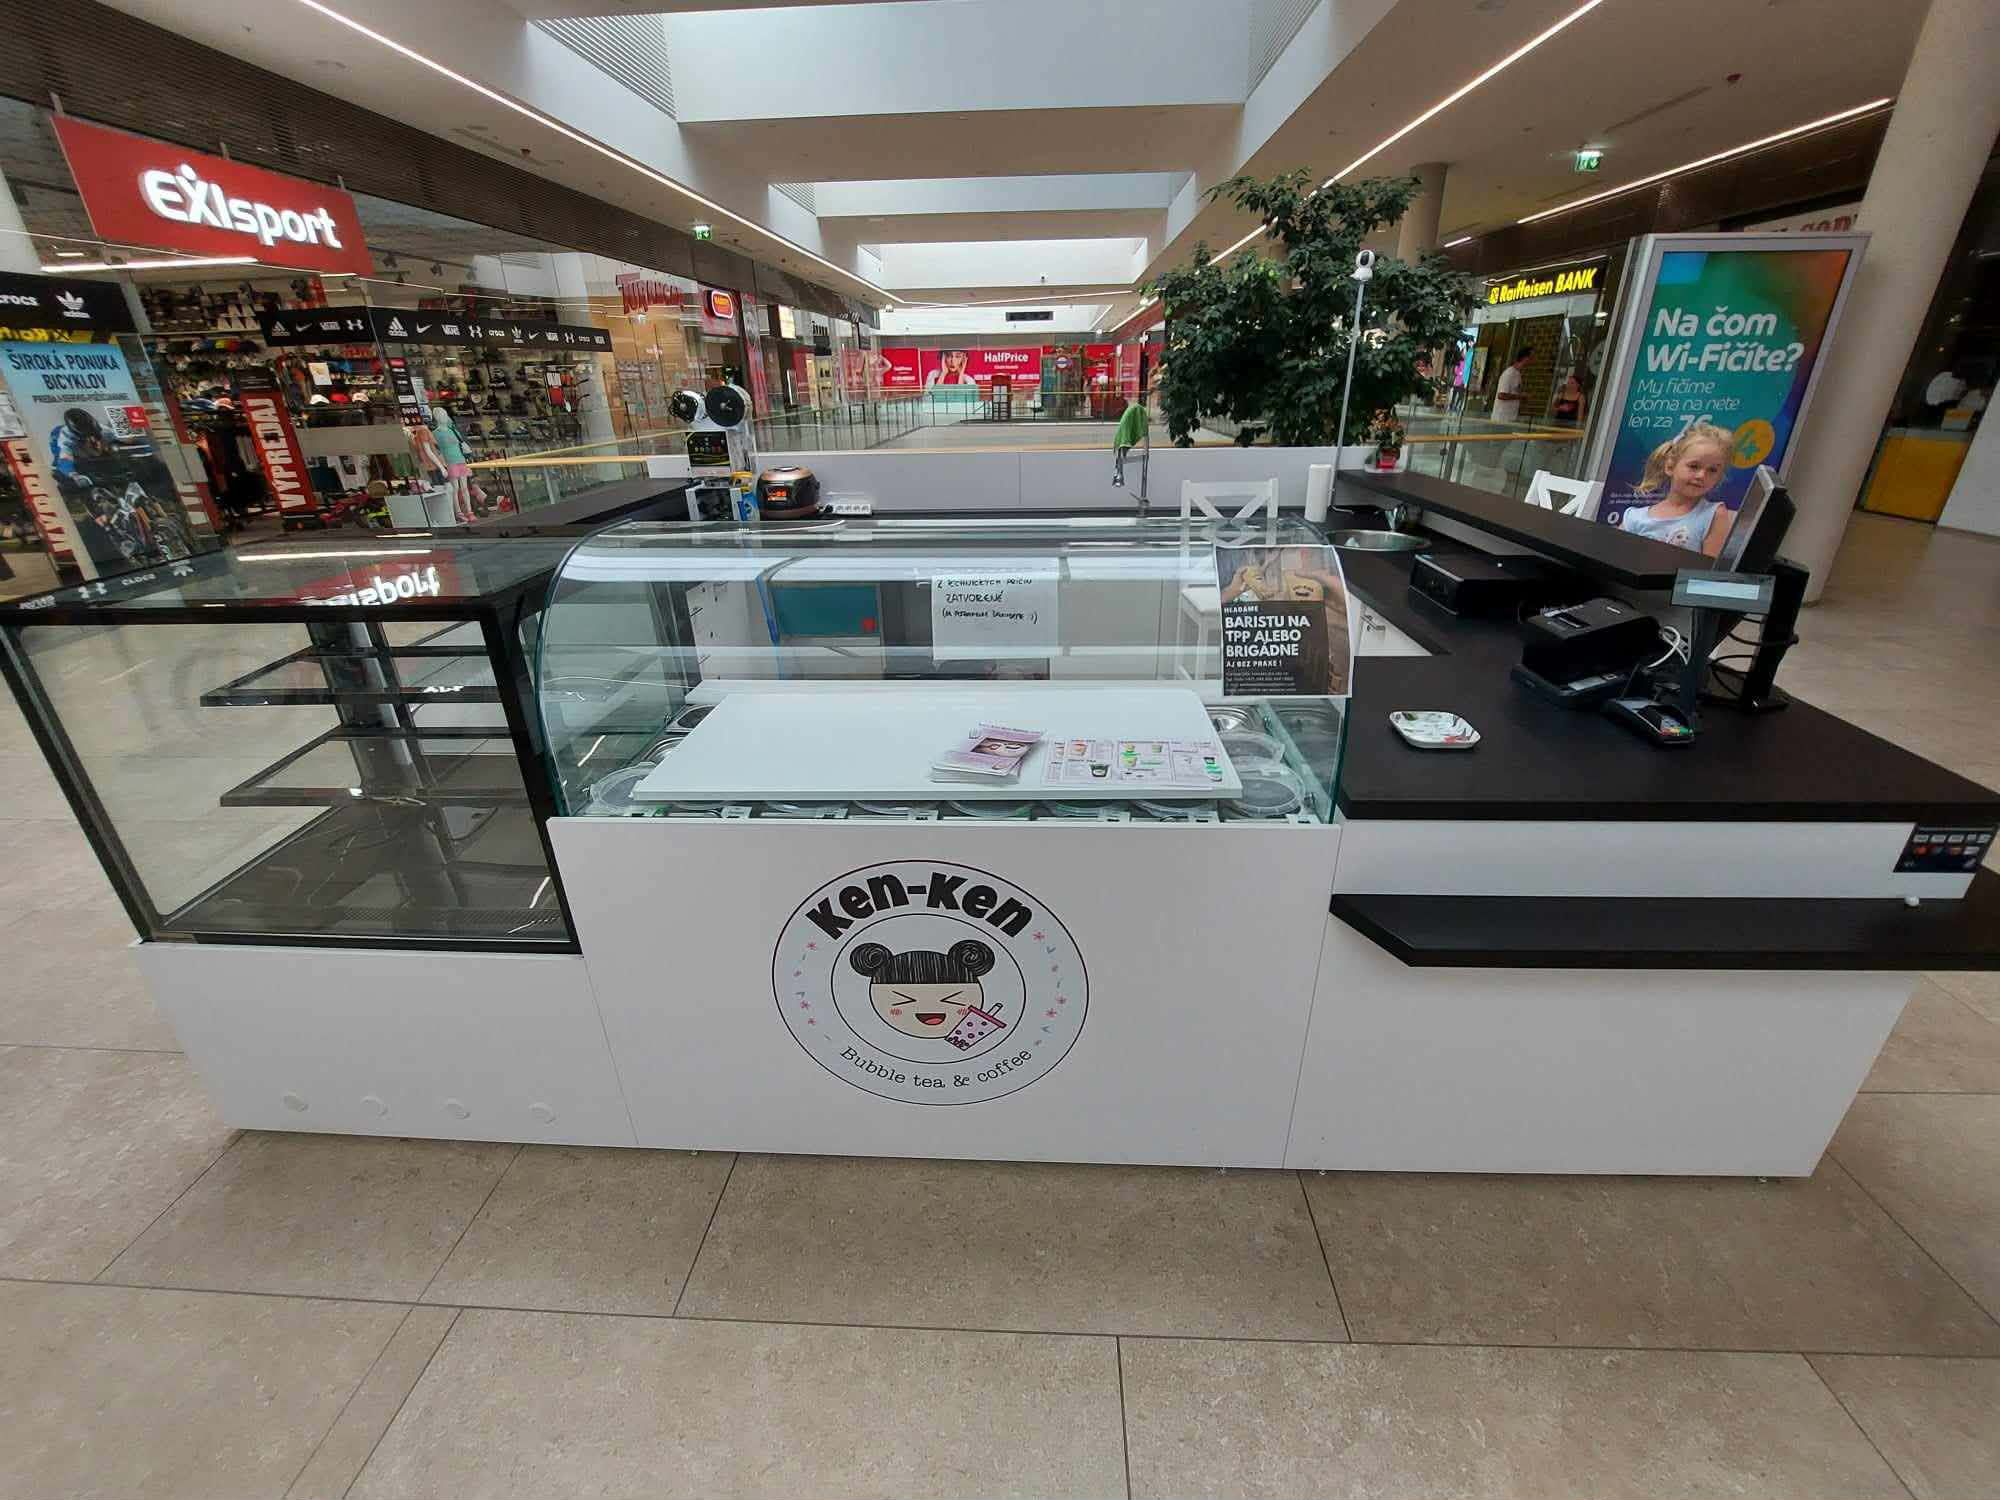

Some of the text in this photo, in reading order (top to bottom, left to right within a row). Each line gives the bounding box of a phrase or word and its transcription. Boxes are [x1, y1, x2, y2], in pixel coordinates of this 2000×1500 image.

[1499, 268, 1598, 303] Raiffeisen BANK
[1653, 305, 1777, 337] Na čom
[64, 354, 121, 370] PONUKA
[984, 352, 1029, 363] HalfPrice
[1647, 341, 1805, 373] Wi-Fičíte?
[1637, 379, 1664, 397] My
[1632, 398, 1741, 412] doma na nete
[1628, 414, 1651, 428] len
[1653, 416, 1674, 428] za
[1225, 615, 1311, 628] BARISTU NA
[1225, 629, 1302, 642] TPP ALEBO
[1226, 642, 1299, 657] BRIGÁDNE
[1226, 660, 1236, 668] AJ
[805, 872, 1033, 941] Ken-Ken
[839, 1046, 1033, 1089] Bubble tea & coffee
